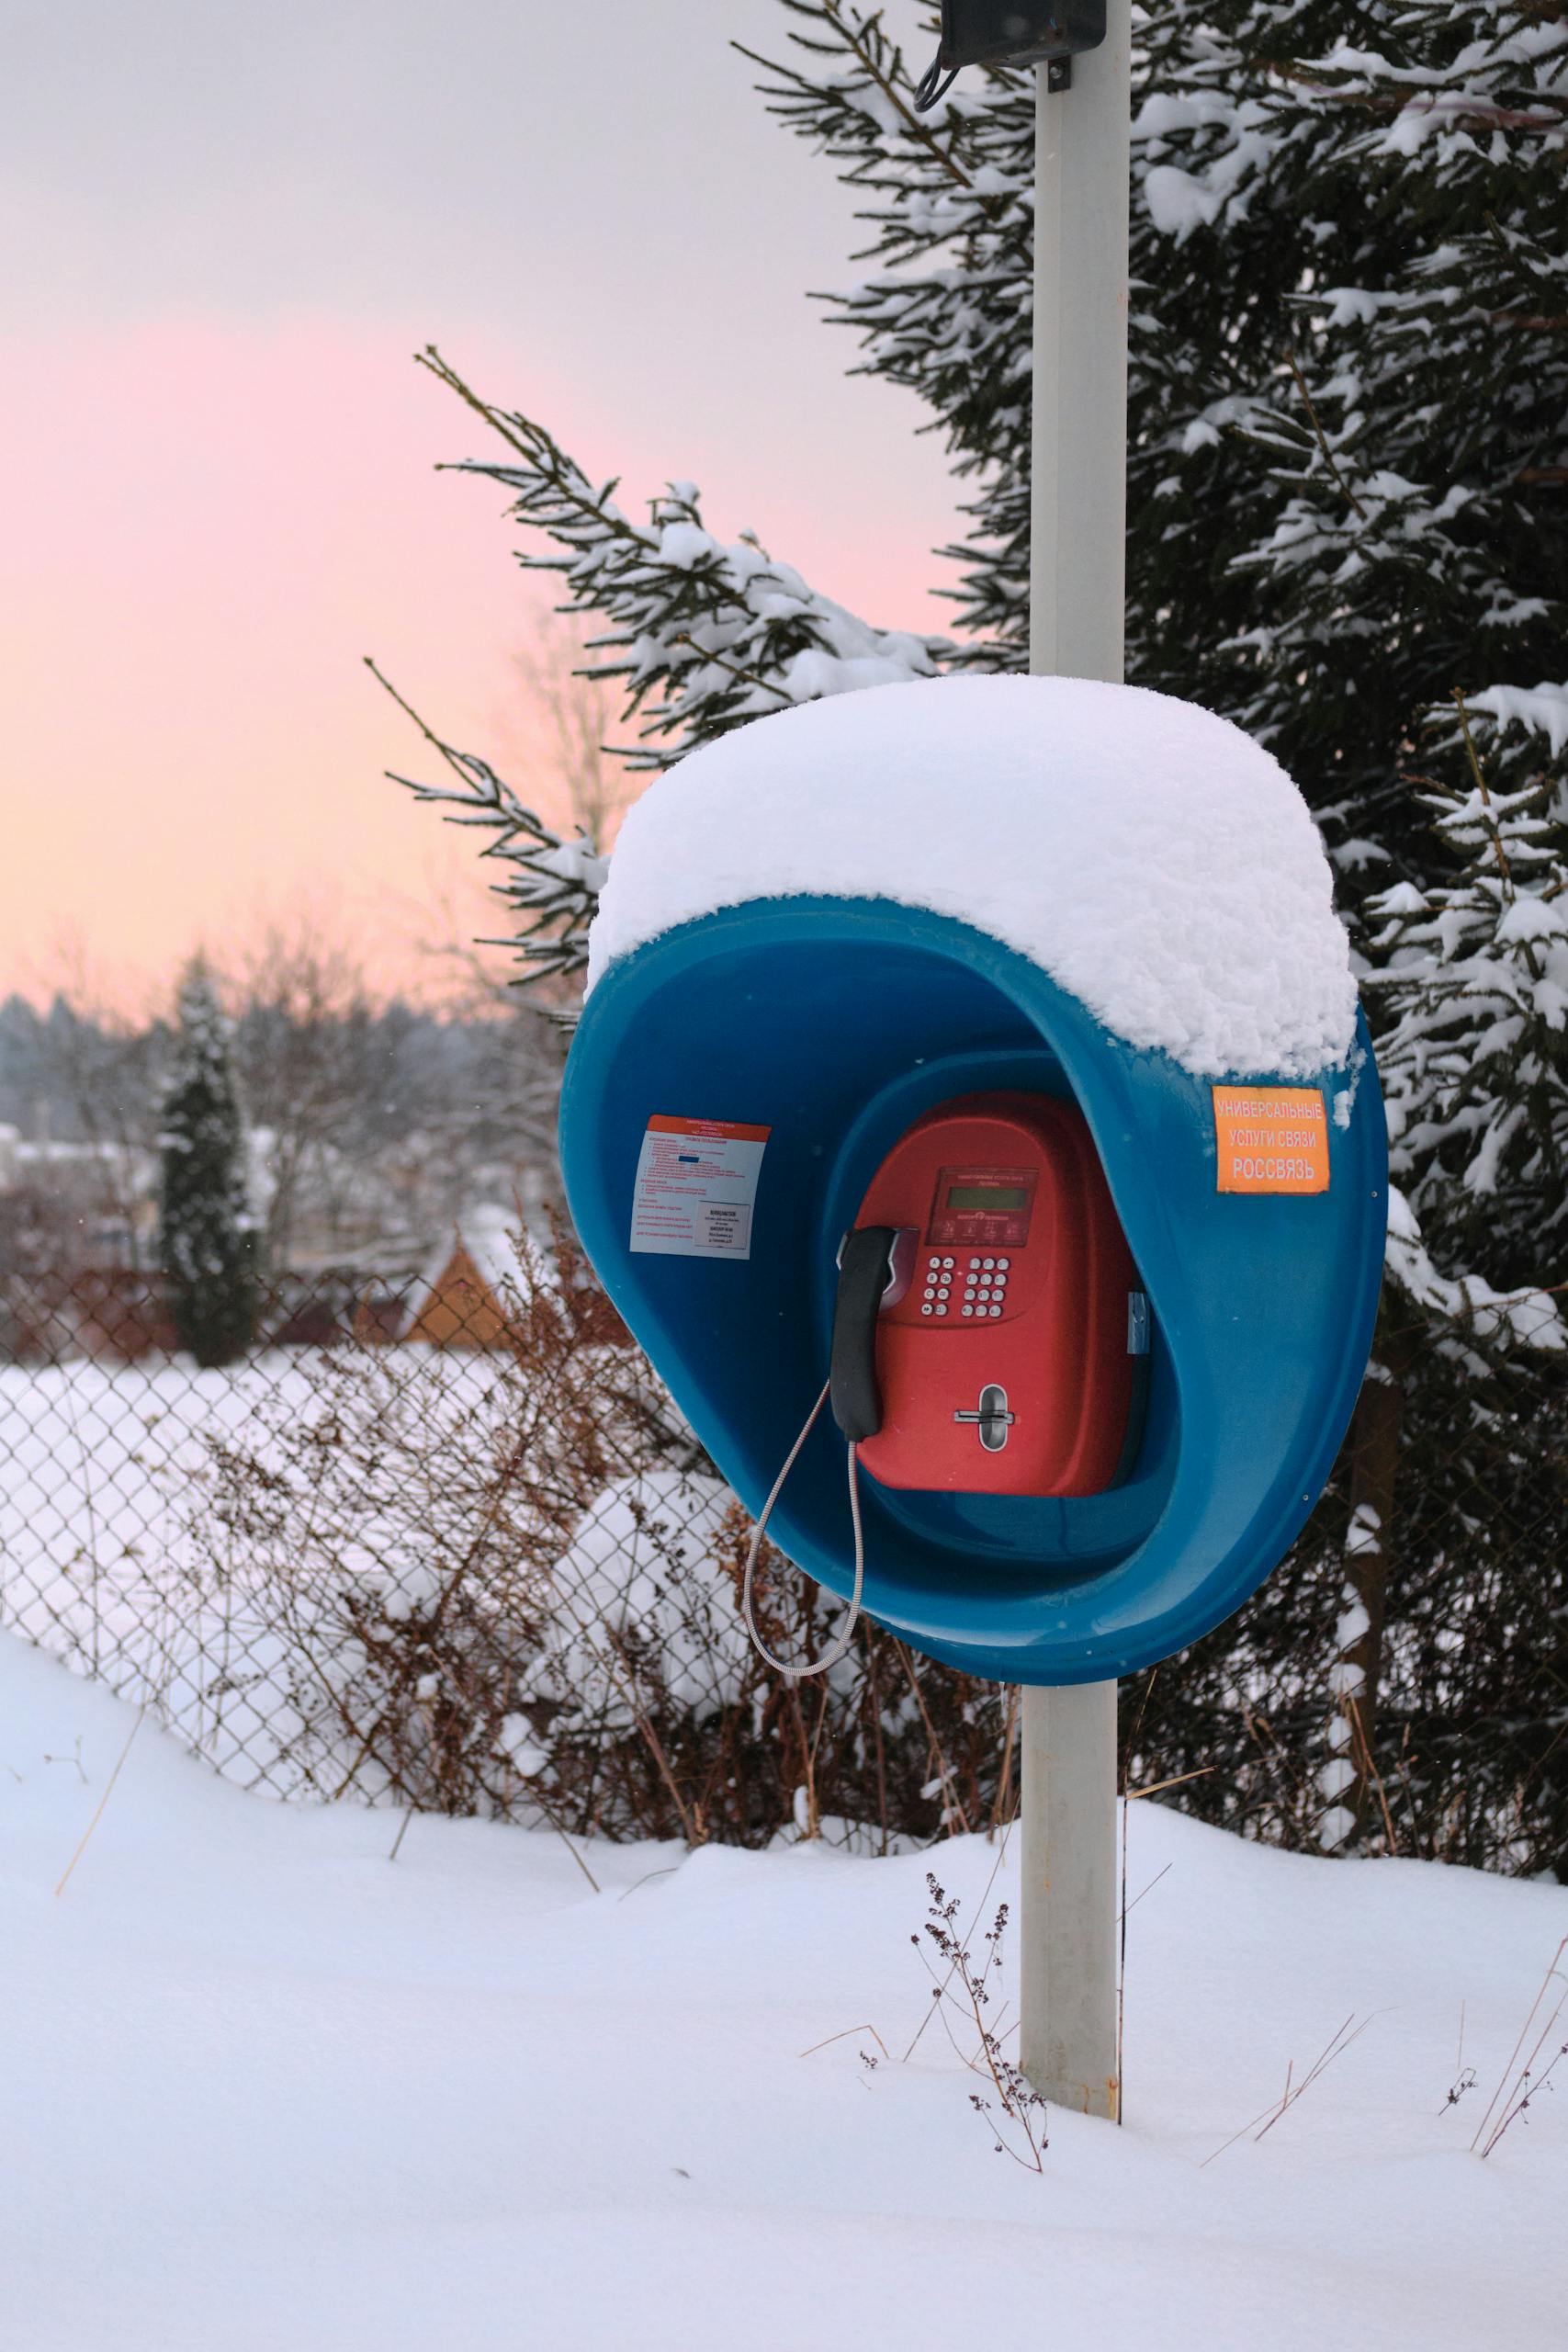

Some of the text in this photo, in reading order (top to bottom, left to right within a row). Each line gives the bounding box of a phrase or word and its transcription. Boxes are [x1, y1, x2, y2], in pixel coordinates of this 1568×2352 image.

[1217, 1100, 1323, 1120] УНИВЕРСАЛЬНЫЕ
[1229, 1129, 1316, 1148] УСЛУГИ СВЯЗИ
[1233, 1157, 1315, 1180] РОССВЯЗЬ
